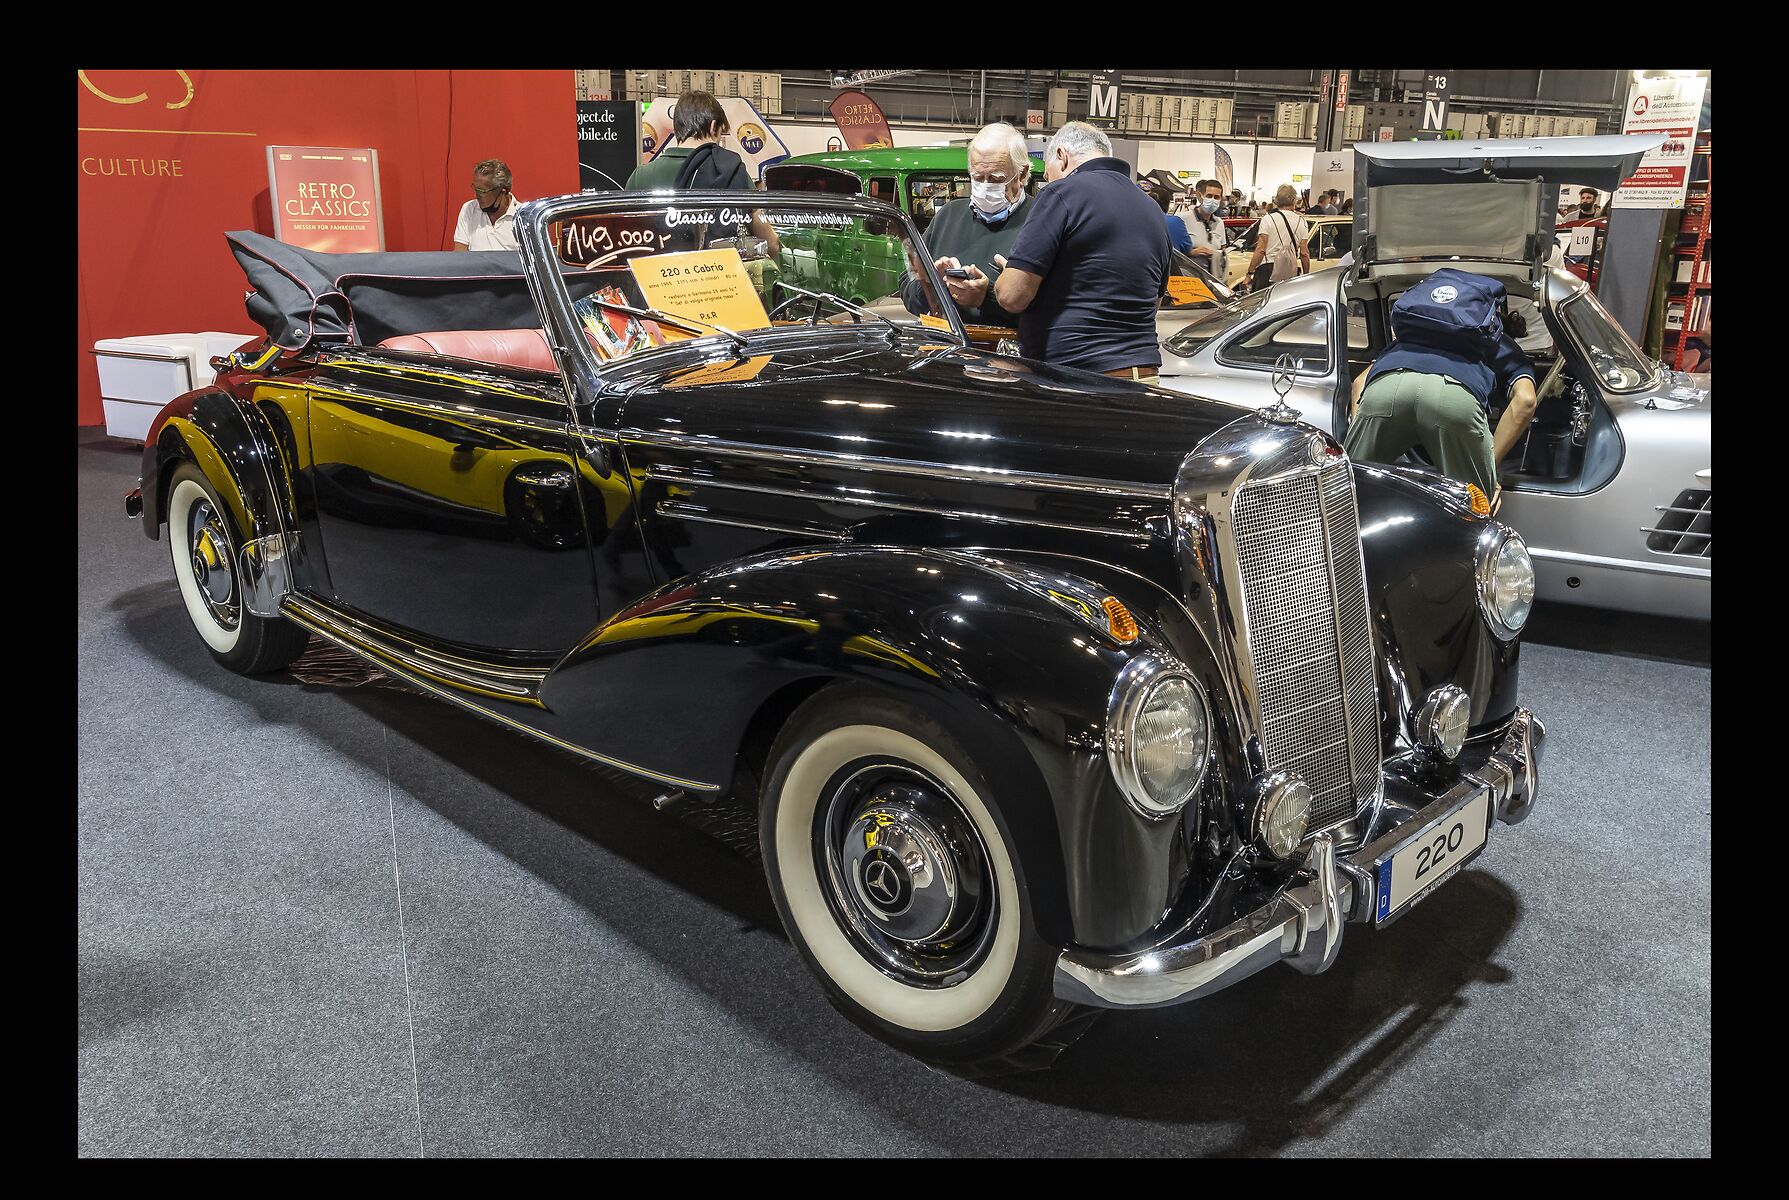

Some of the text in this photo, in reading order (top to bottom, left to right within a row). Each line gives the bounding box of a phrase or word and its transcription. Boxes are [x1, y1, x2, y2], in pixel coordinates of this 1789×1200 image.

[1434, 76, 1447, 89] 13
[1089, 84, 1118, 117] M
[1028, 115, 1043, 124] 13G
[1423, 100, 1446, 130] N
[1381, 131, 1392, 139] 13F
[81, 157, 184, 177] CULTURE
[298, 182, 356, 199] RETRO
[285, 199, 371, 217] CLASSICS
[665, 207, 855, 228] Classic Cars www.omautomobile.de
[318, 223, 328, 231] FÜR
[1576, 235, 1590, 245] L10
[660, 266, 680, 278] 220
[693, 262, 724, 274] Cabrio
[1415, 822, 1464, 881] 220
[1381, 895, 1387, 909] D
